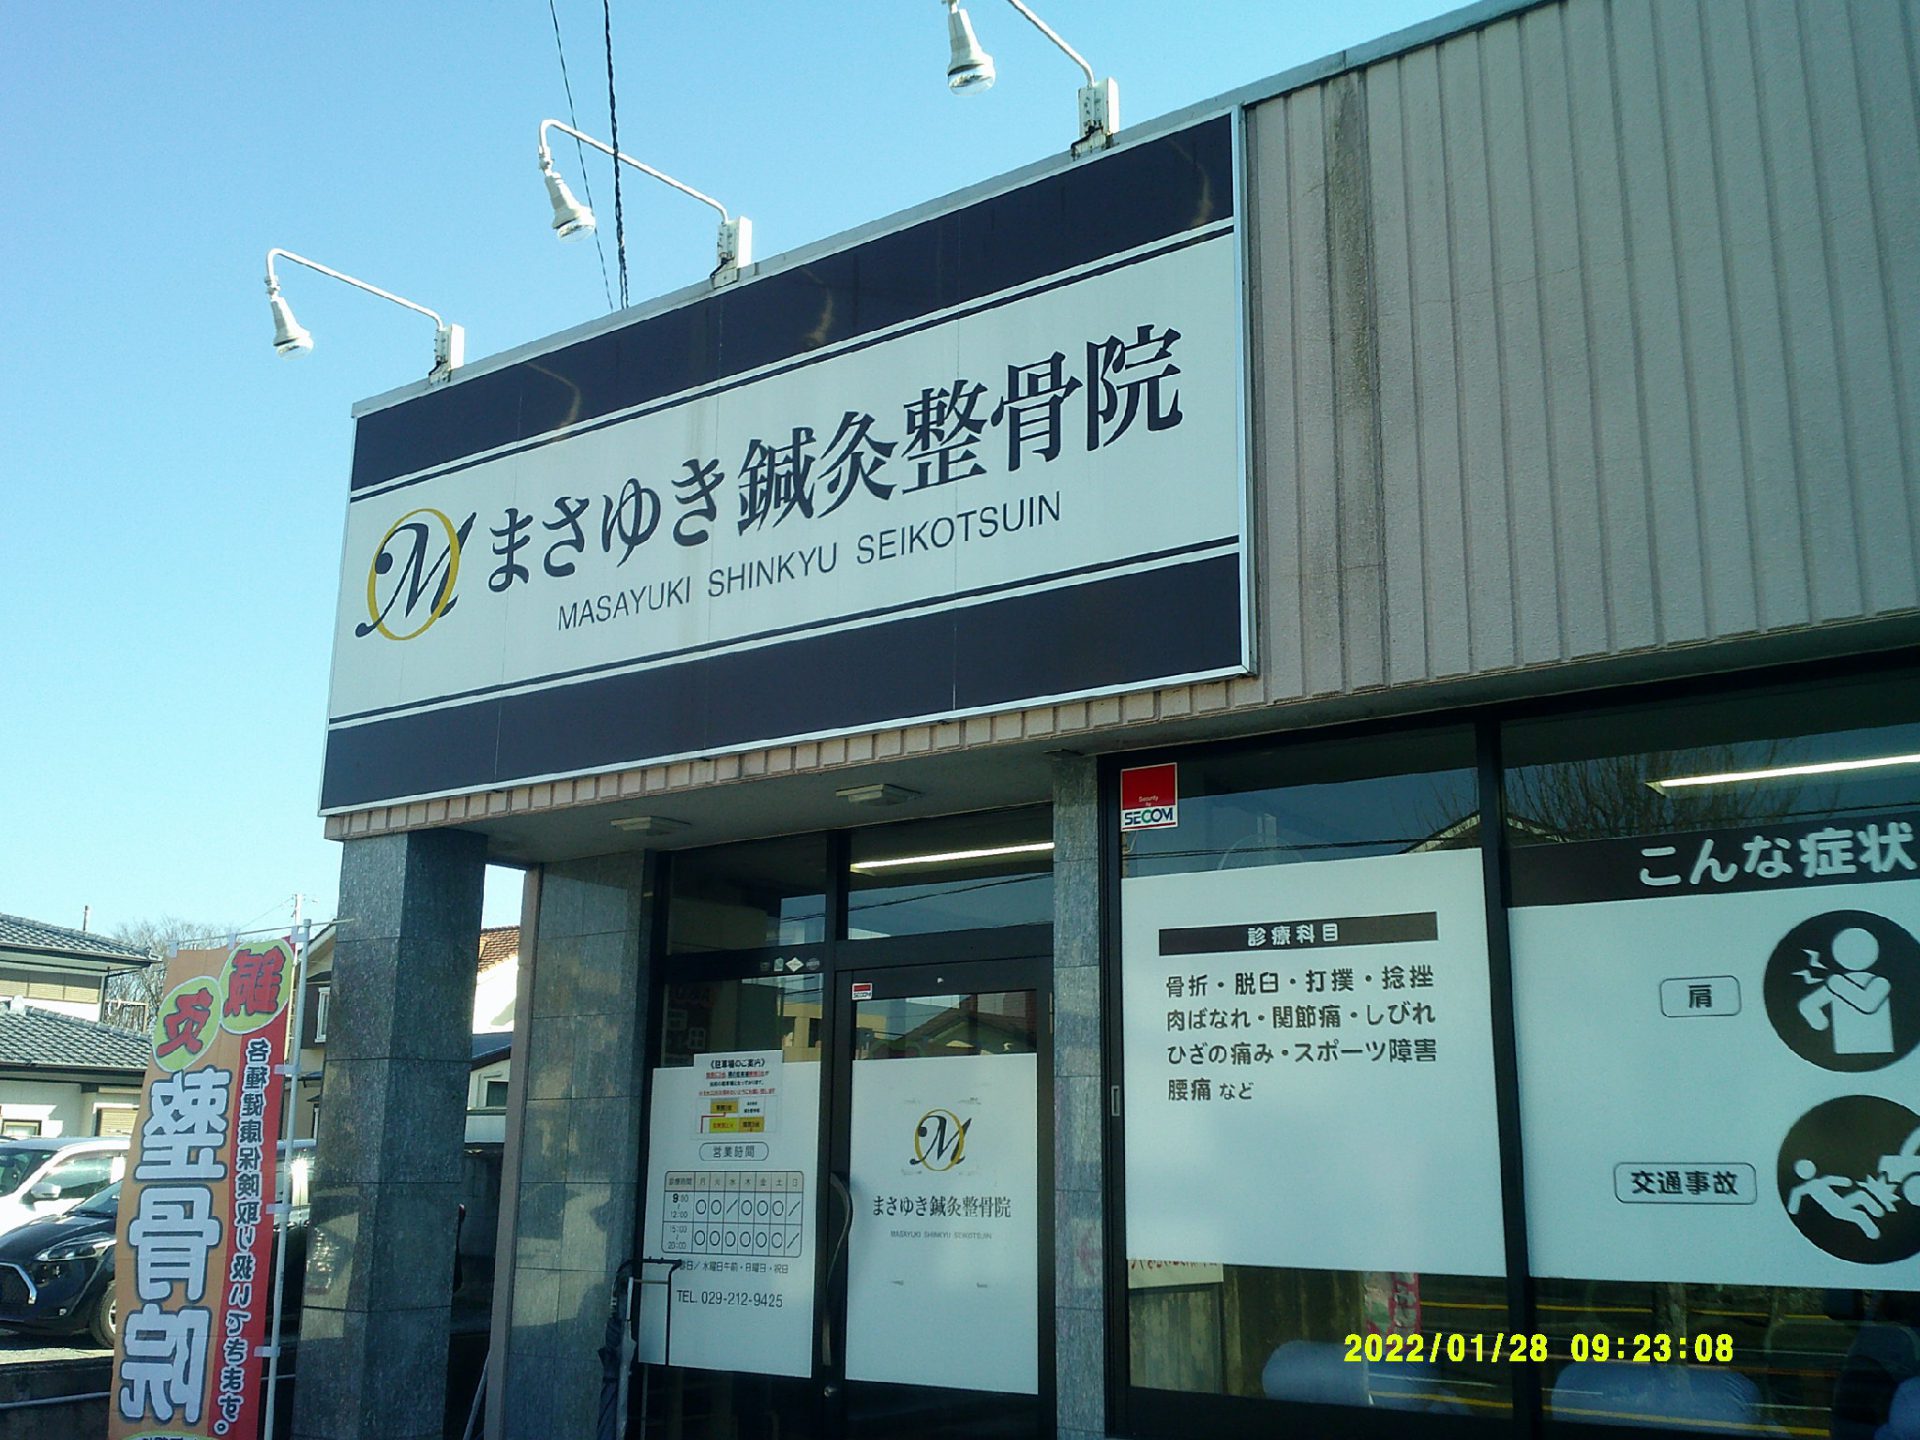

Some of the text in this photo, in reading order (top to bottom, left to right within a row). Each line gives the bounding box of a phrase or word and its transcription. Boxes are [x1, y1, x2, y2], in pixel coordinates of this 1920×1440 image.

[487, 324, 1184, 592] まさゆき鍼灸整骨院
[558, 490, 1062, 631] MASAYUKI SHINKYU SEIKOTSUIN
[1125, 807, 1173, 825] SECOM
[1639, 822, 1917, 887] こんな症状
[1248, 923, 1339, 946] 診療科目
[1166, 965, 1434, 998] 骨折・脱臼・打撲・捻挫
[1689, 984, 1712, 1008] 肩
[1167, 1001, 1435, 1032] 肉ばなれ・関節痛・しびれ
[1168, 1038, 1437, 1065] ひざの痛み・スポーツ障害
[1168, 1078, 1254, 1102] 腰痛 など
[713, 1146, 755, 1158] 営業時間
[1631, 1170, 1739, 1196] 交通事故
[873, 1195, 1012, 1218] まさゆき鍼灸整骨院
[701, 1291, 783, 1308] 029-212-9425
